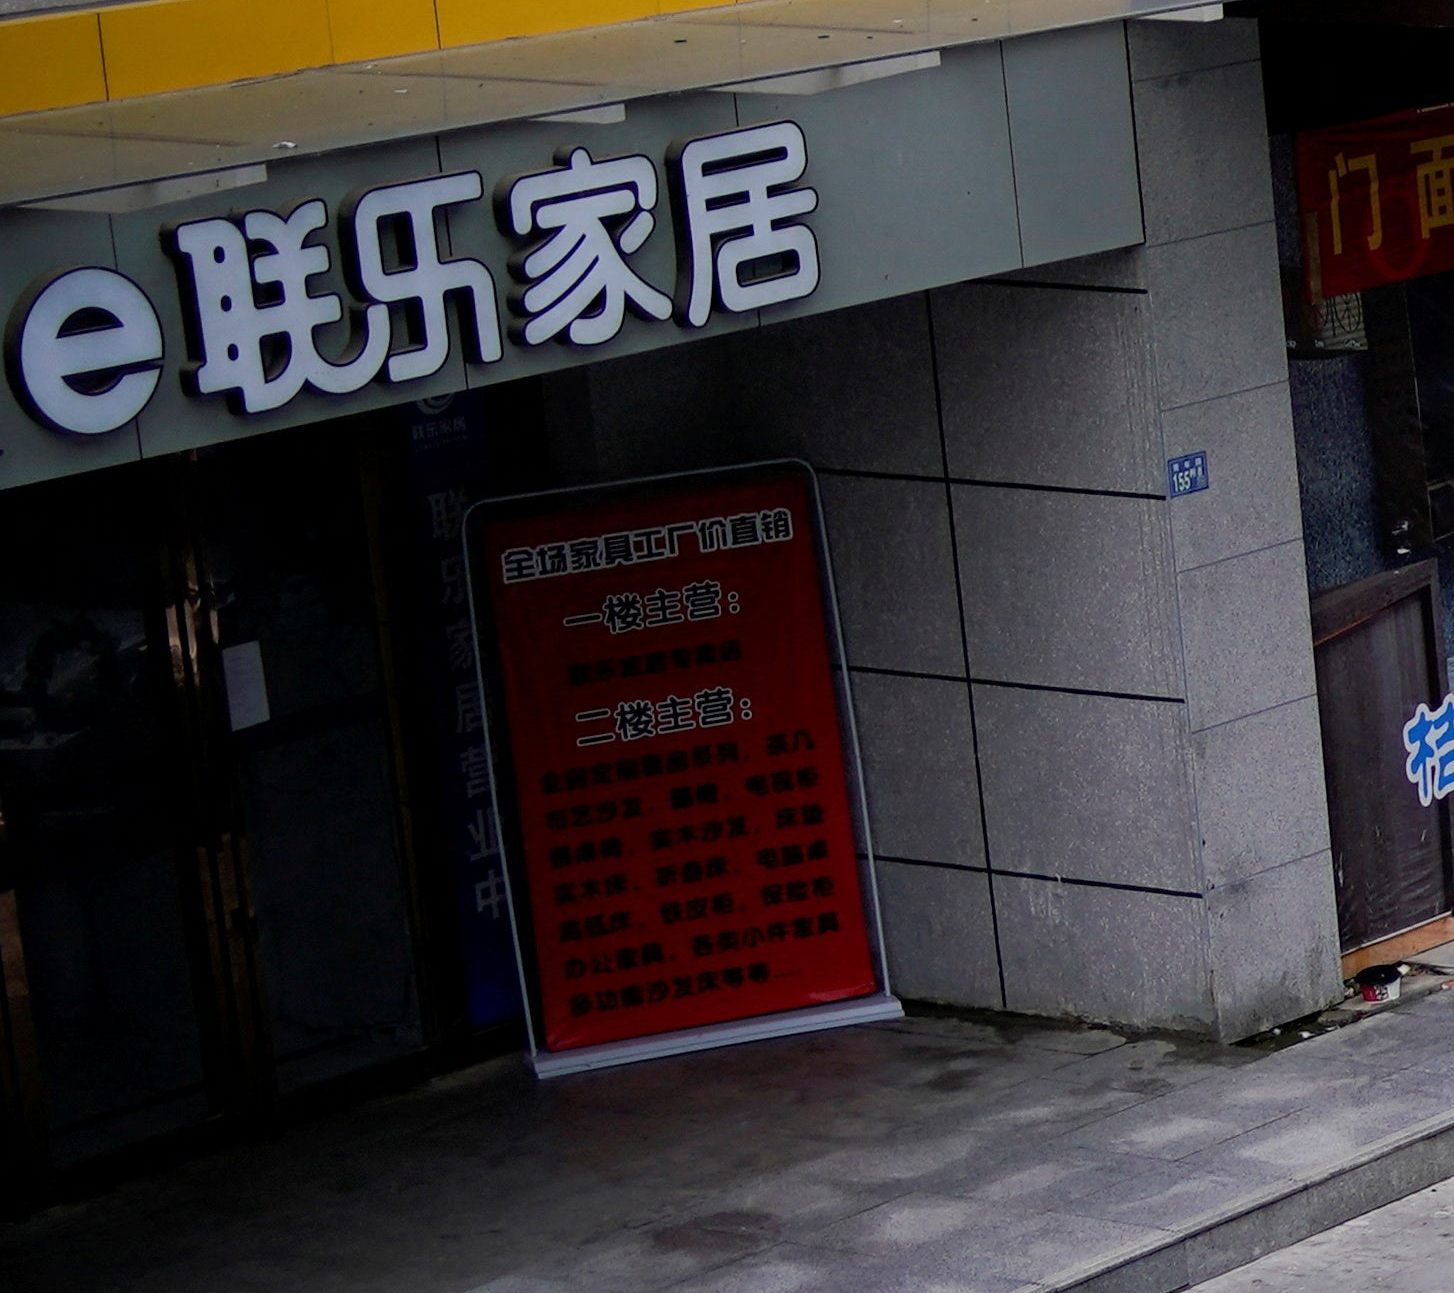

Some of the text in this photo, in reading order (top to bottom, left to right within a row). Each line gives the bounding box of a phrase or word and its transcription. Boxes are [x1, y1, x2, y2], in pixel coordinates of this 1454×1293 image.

[501, 507, 795, 584] 全场家具工厂价直销
